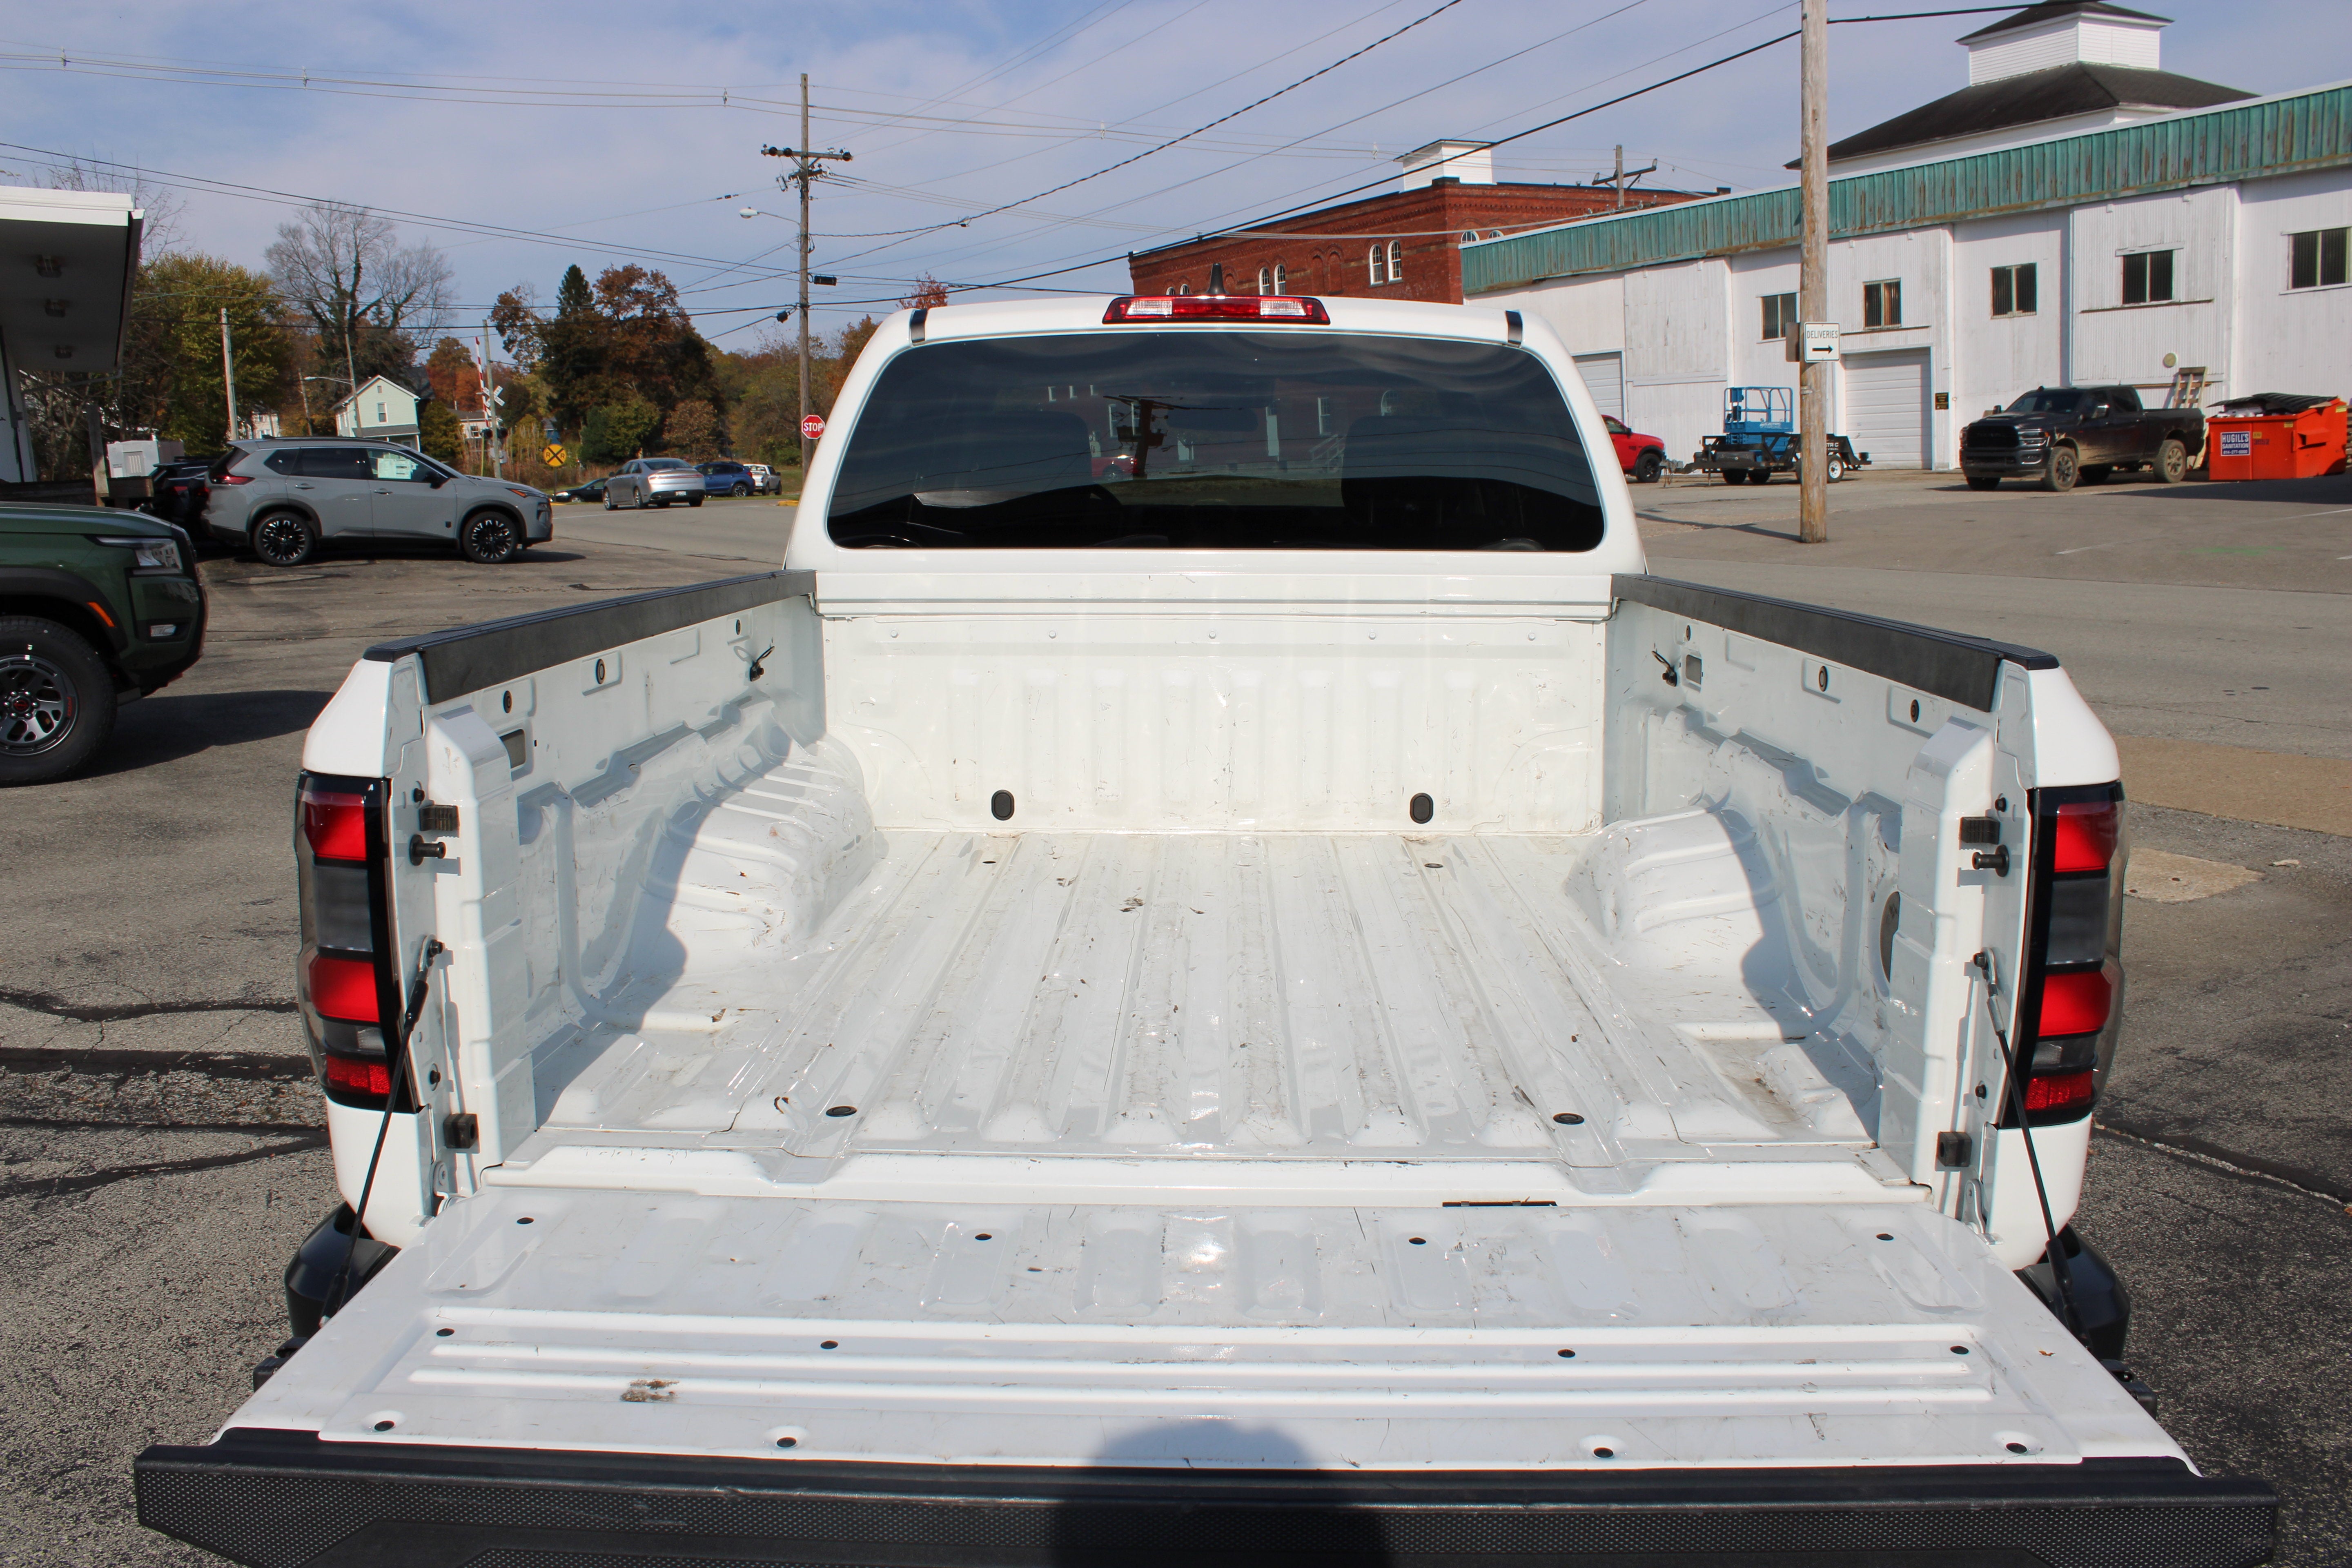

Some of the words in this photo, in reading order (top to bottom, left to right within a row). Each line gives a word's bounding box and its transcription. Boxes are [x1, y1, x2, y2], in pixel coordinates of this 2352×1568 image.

[1806, 330, 1838, 339] DELIVERIES
[803, 422, 823, 432] STOP
[2222, 434, 2249, 443] HUGILL'S
